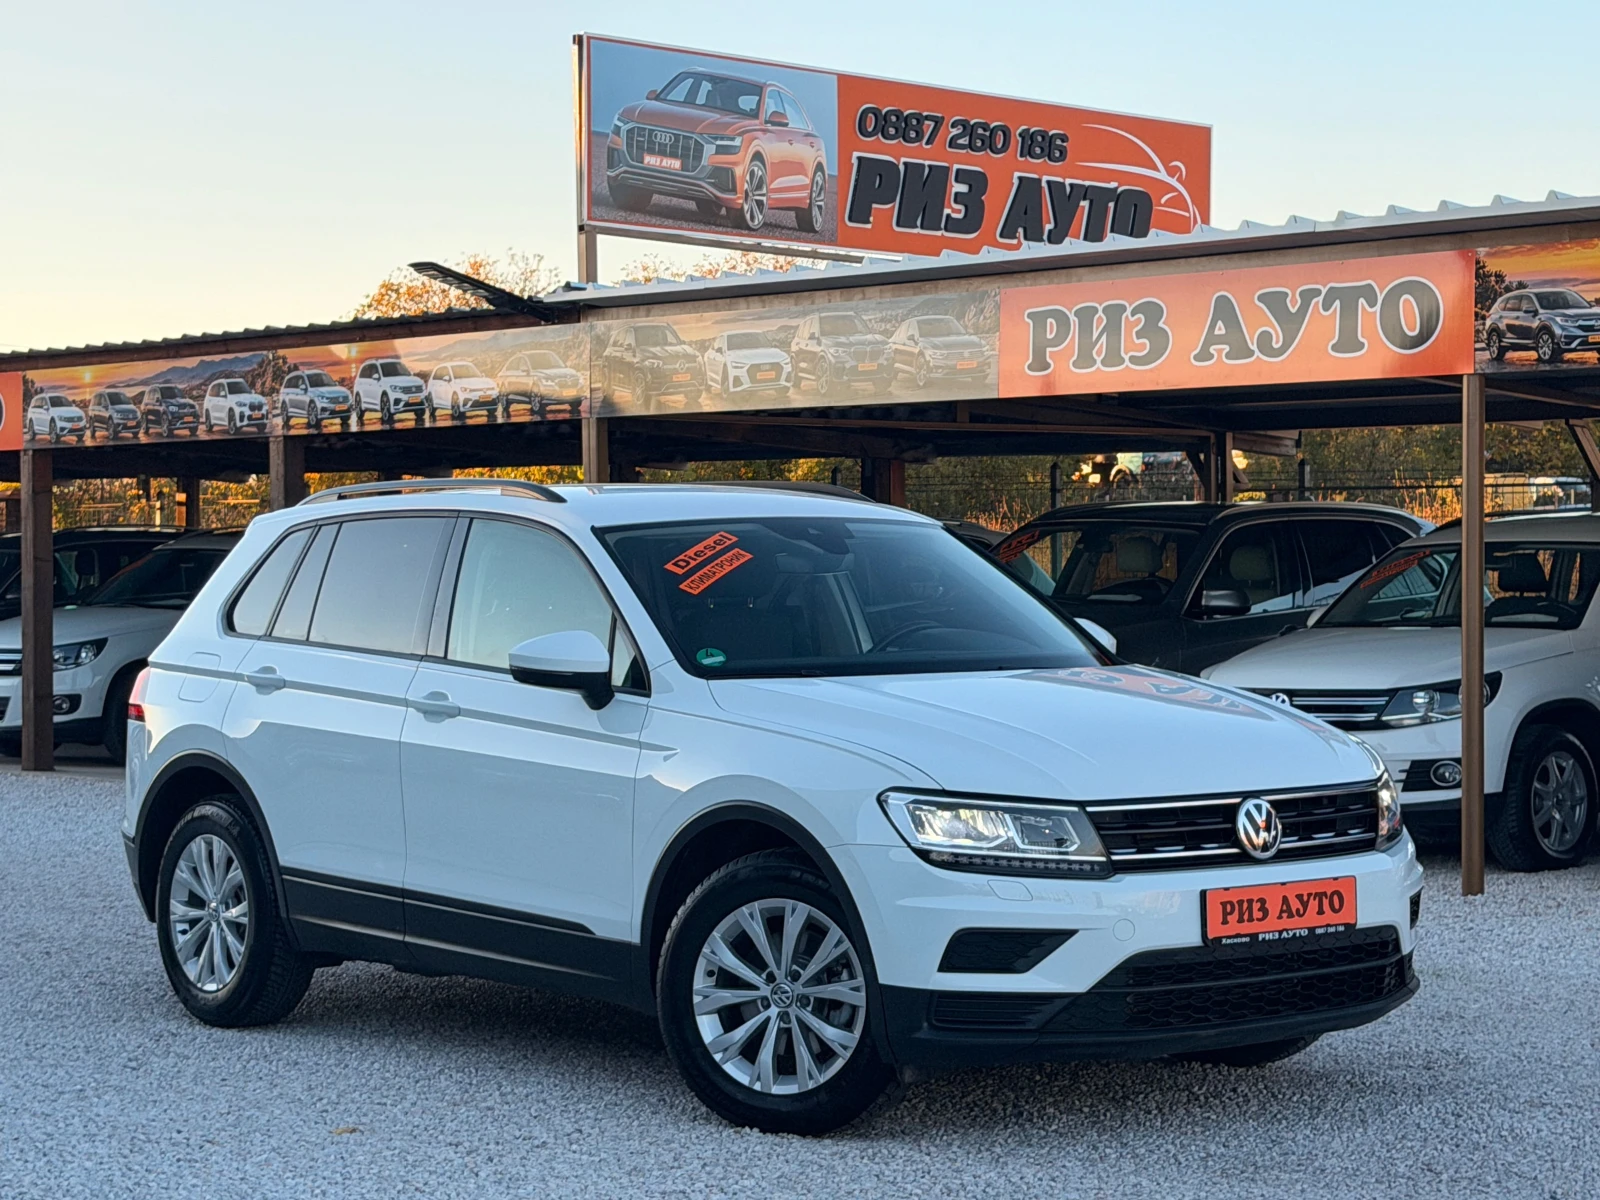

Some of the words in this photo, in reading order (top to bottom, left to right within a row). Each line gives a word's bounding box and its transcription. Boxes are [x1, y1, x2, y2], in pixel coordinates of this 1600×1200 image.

[857, 104, 945, 147] 0887
[947, 116, 1011, 157] 260
[1016, 126, 1069, 165] 186
[845, 152, 988, 238] РИЗ
[996, 172, 1153, 245] АУТО
[1024, 297, 1172, 375] РИЗ
[1191, 276, 1444, 366] АУТО
[672, 533, 733, 570] Diesel
[684, 550, 746, 592] КЛИМАТРОНИК
[1219, 897, 1269, 925] РИЗ
[1276, 889, 1344, 920] АУТО
[1258, 931, 1280, 942] РИЗ
[1281, 928, 1309, 939] АУТО
